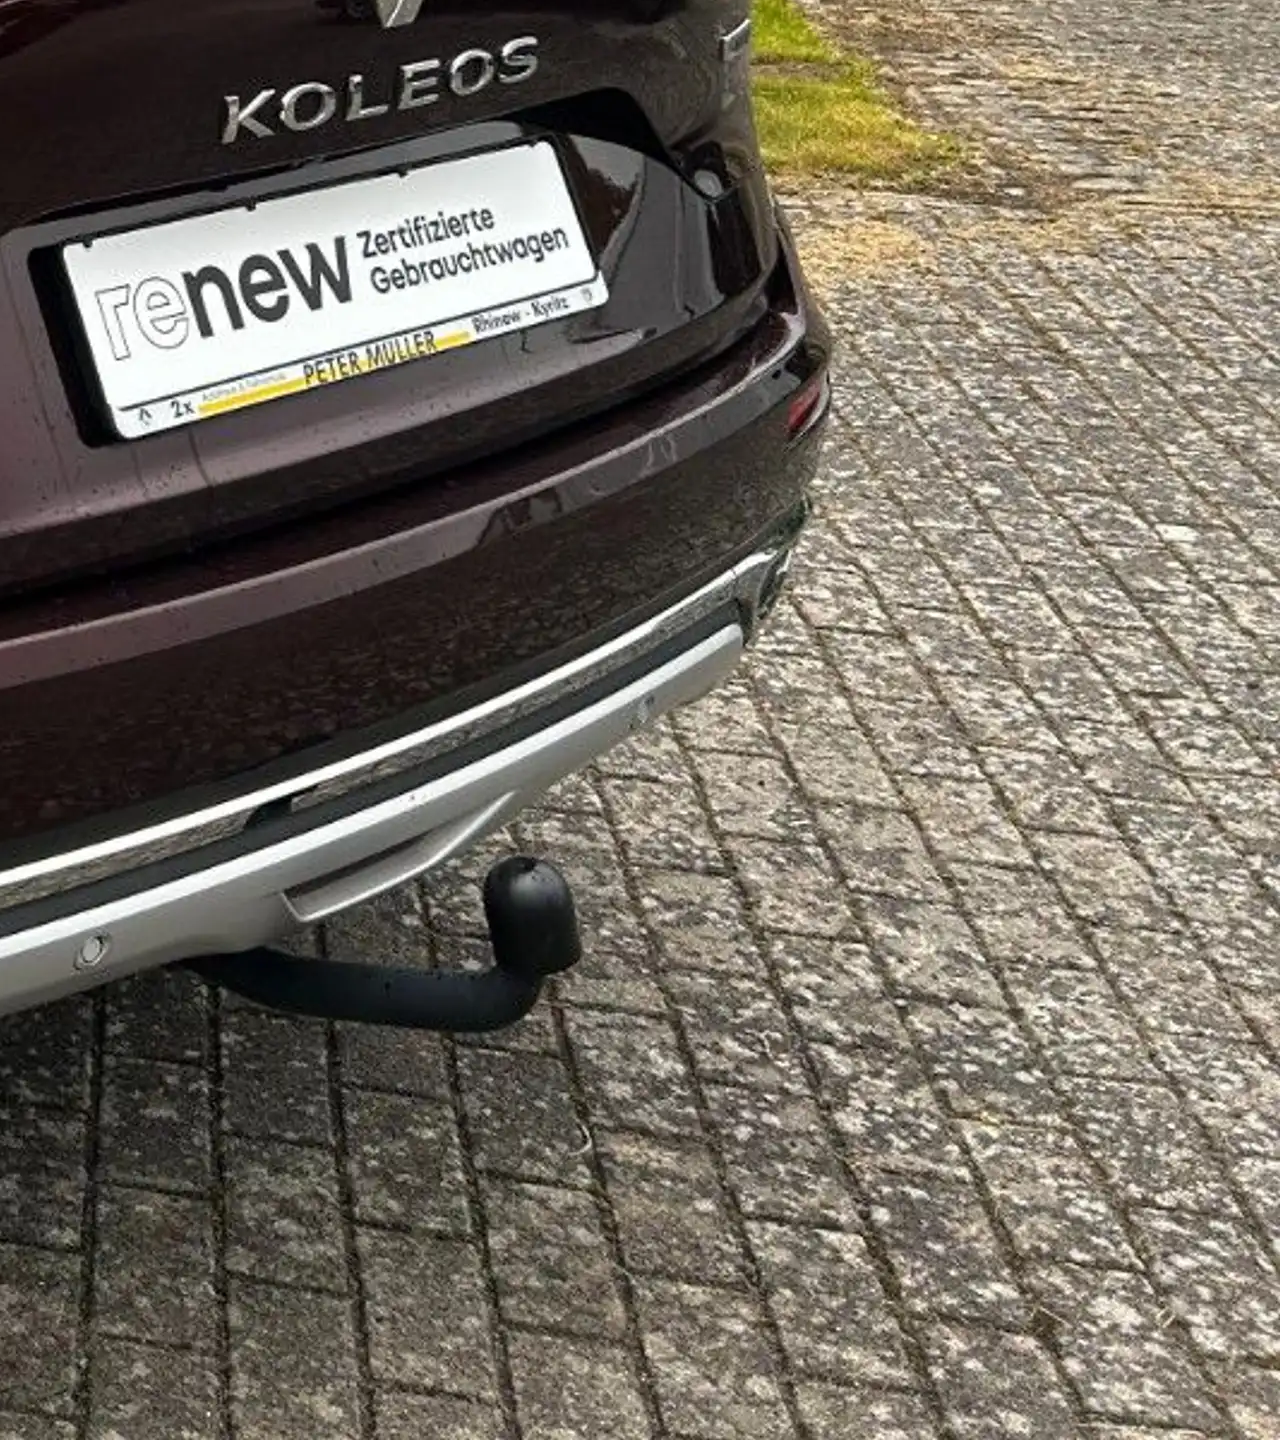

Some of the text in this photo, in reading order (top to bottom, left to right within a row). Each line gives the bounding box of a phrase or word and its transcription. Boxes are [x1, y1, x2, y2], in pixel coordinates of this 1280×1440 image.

[220, 35, 539, 145] KOLEOS
[356, 207, 496, 259] Zertifizierte
[370, 227, 570, 294] Gebrauchtwagen
[94, 235, 353, 361] renew
[302, 354, 361, 386] PETER
